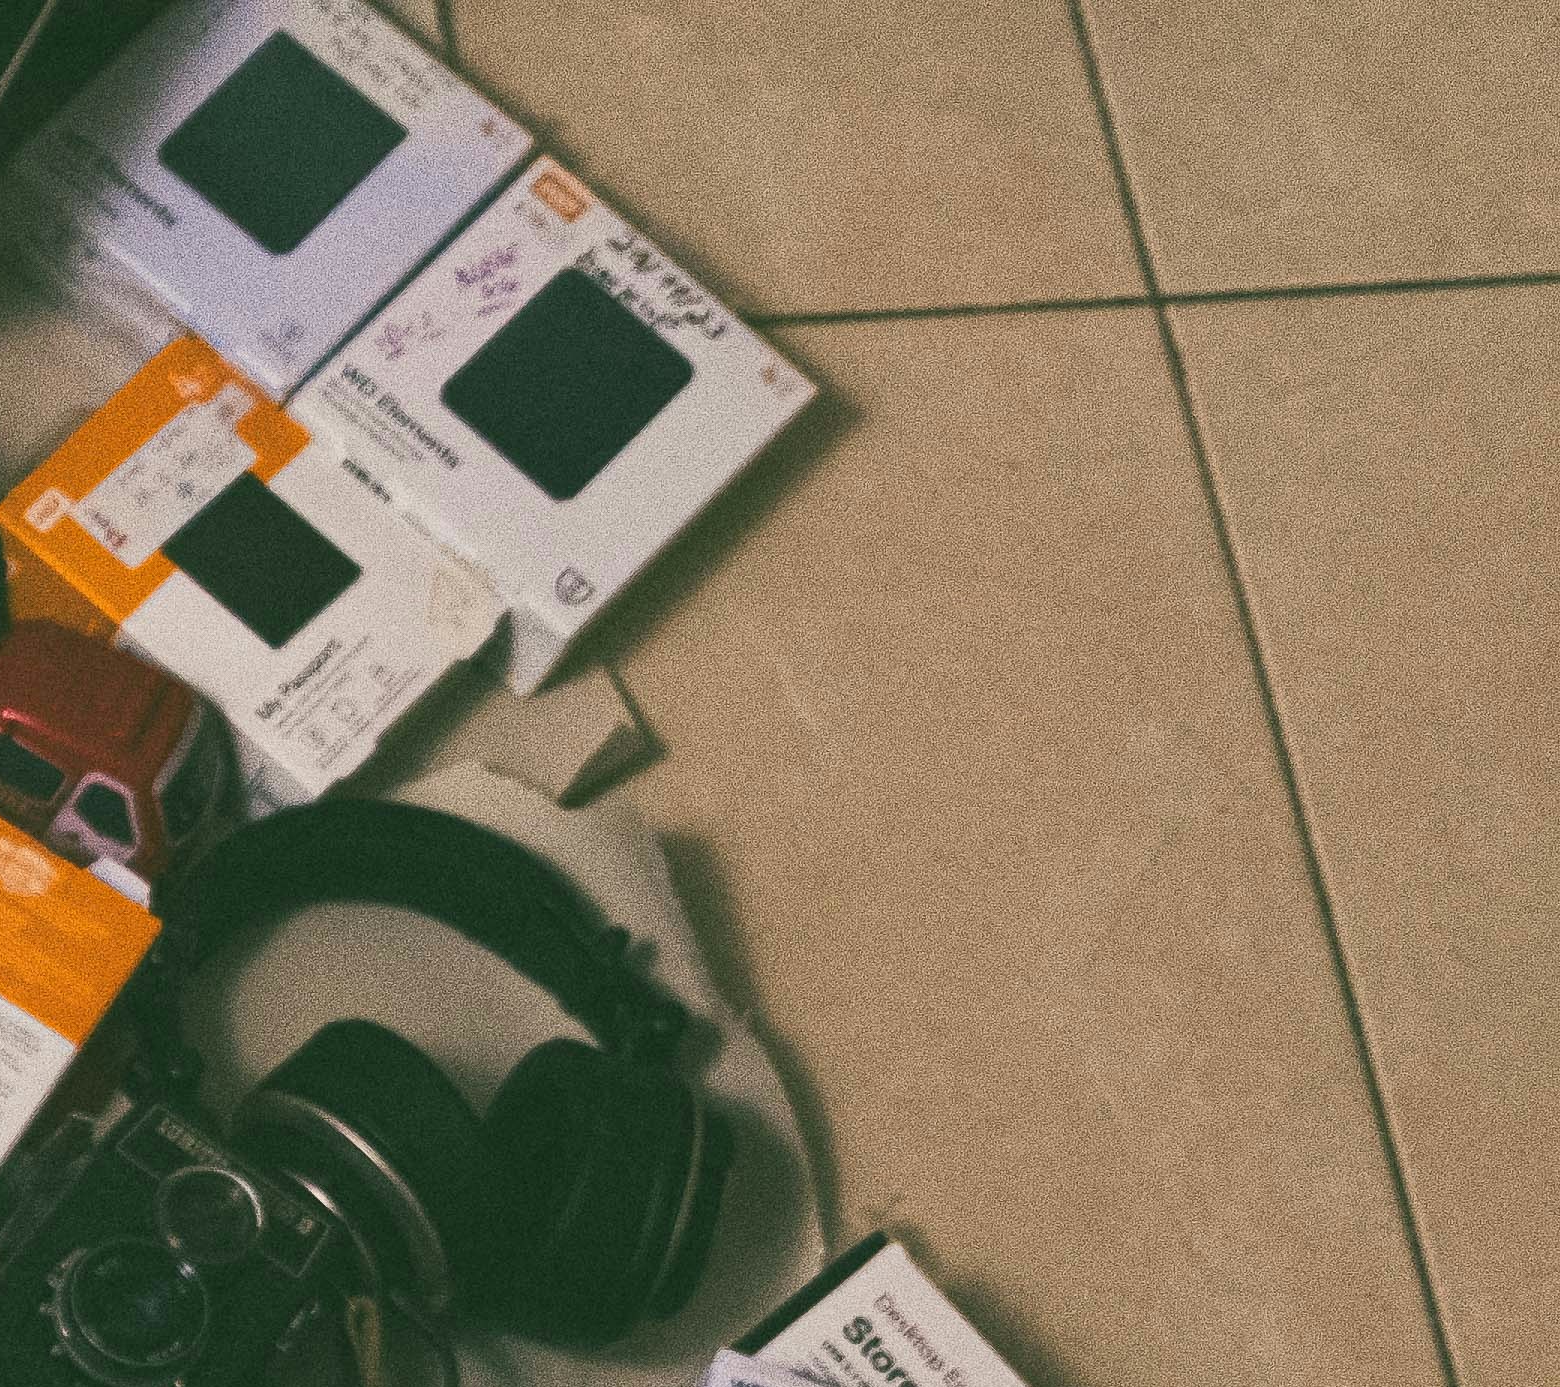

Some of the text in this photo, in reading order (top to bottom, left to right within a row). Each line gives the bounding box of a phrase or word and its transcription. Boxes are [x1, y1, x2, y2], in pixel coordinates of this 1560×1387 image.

[338, 359, 380, 401] WD
[374, 390, 462, 474] Elements
[253, 691, 286, 724] My
[276, 636, 347, 700] Passport
[868, 1291, 951, 1374] Desktop
